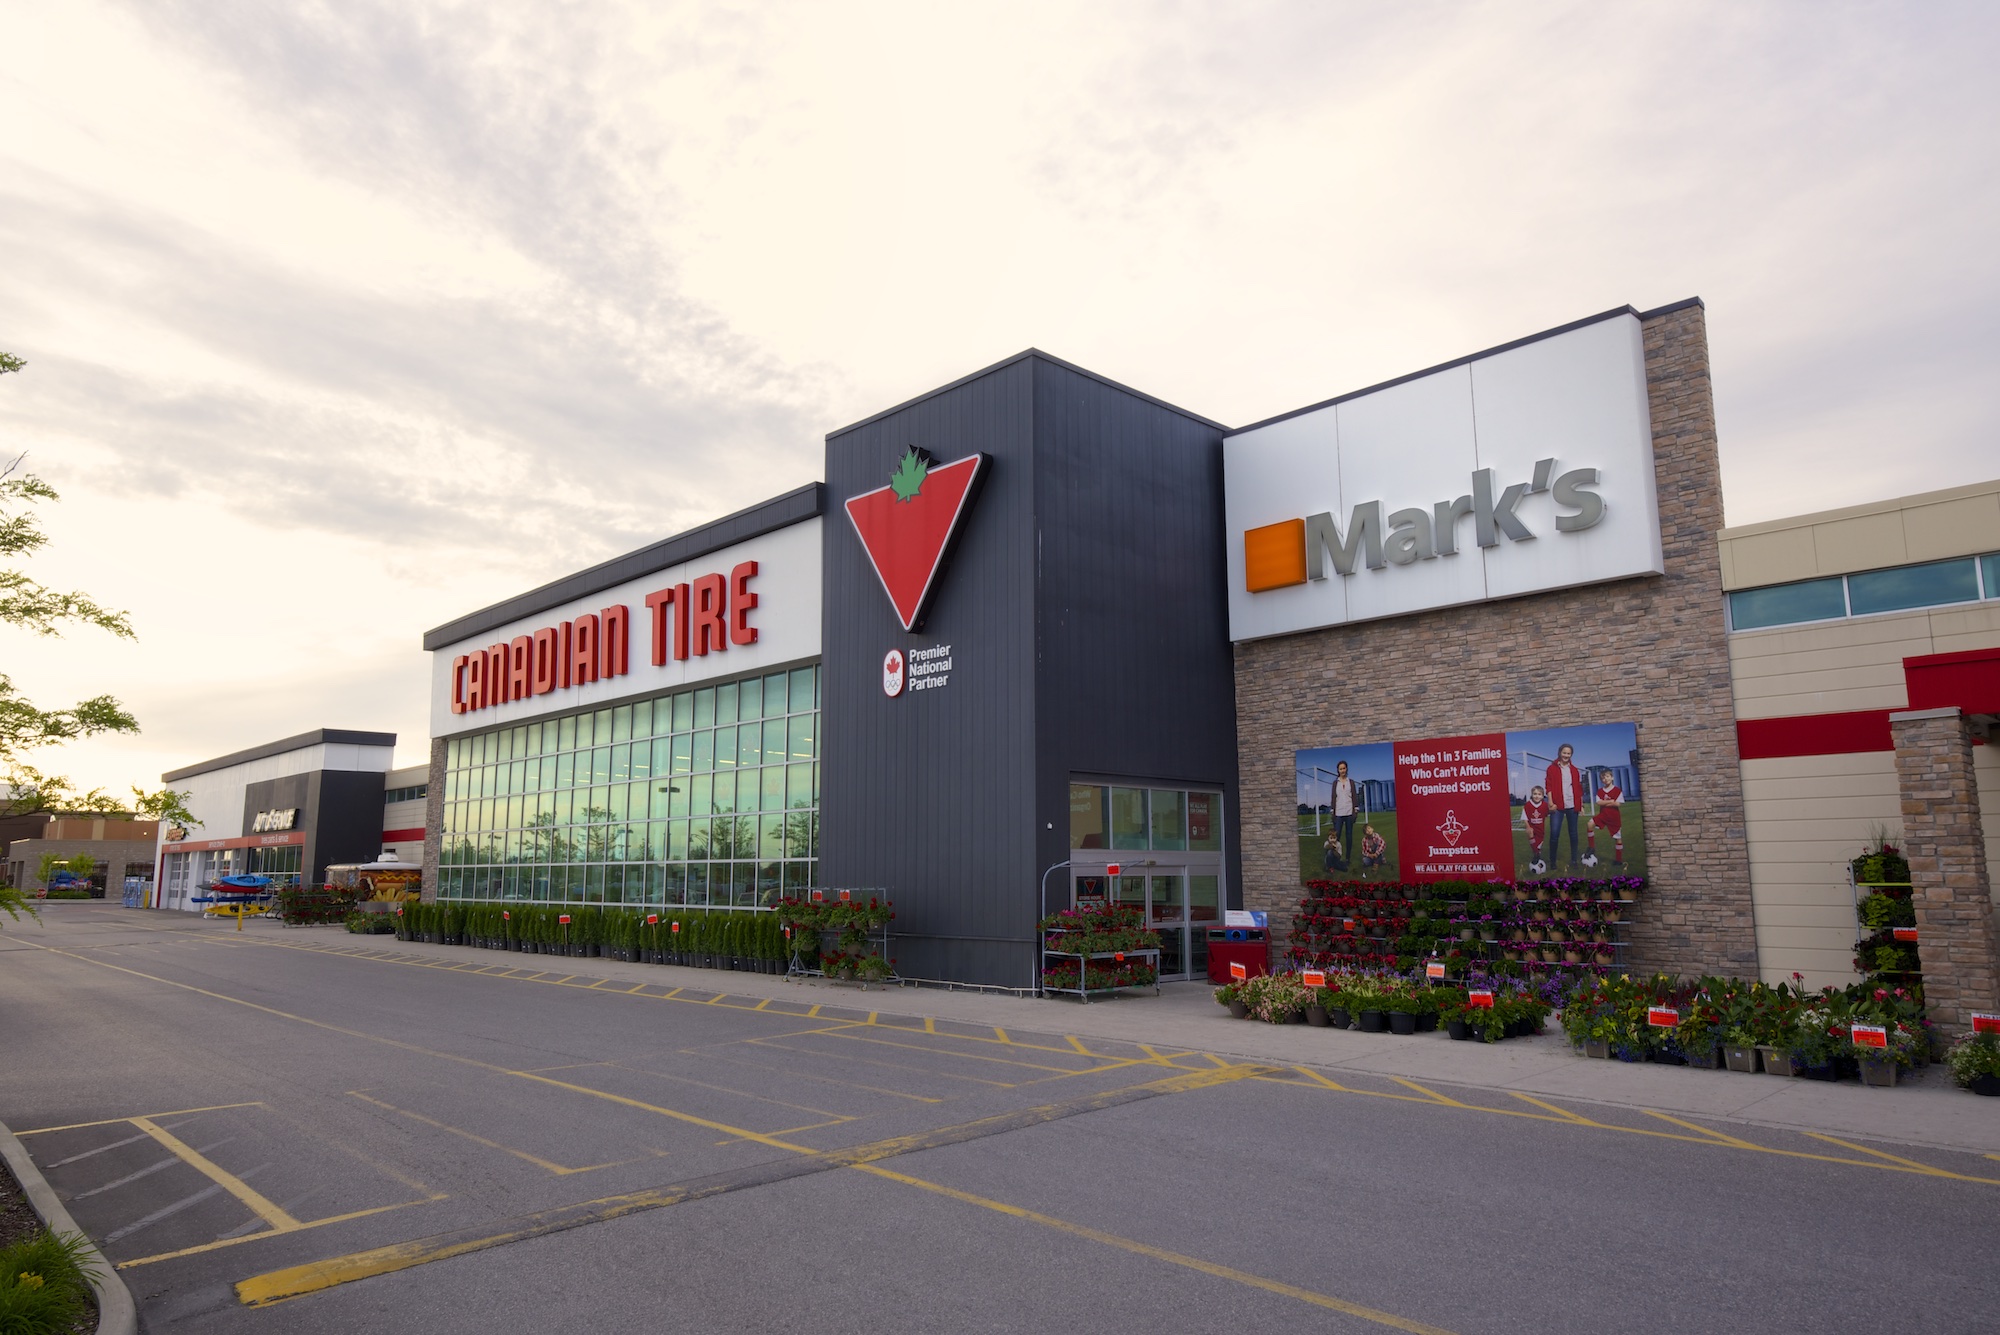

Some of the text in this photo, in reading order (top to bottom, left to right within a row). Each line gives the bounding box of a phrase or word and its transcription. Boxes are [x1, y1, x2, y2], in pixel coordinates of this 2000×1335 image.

[1305, 458, 1607, 582] Mark's
[451, 560, 758, 715] CANADIAN TIRE
[909, 644, 951, 662] Premier
[909, 657, 952, 677] National
[908, 675, 949, 692] Partner
[1398, 748, 1502, 766] Help the 1 in 3 Families
[1410, 764, 1490, 780] Who Can't Afford
[1411, 780, 1491, 796] Organized Sports
[1428, 845, 1479, 857] Jumpstart
[1415, 864, 1426, 872] WE
[1426, 864, 1437, 872] ALL
[1438, 864, 1454, 872] PLAY
[1454, 864, 1468, 872] FOR
